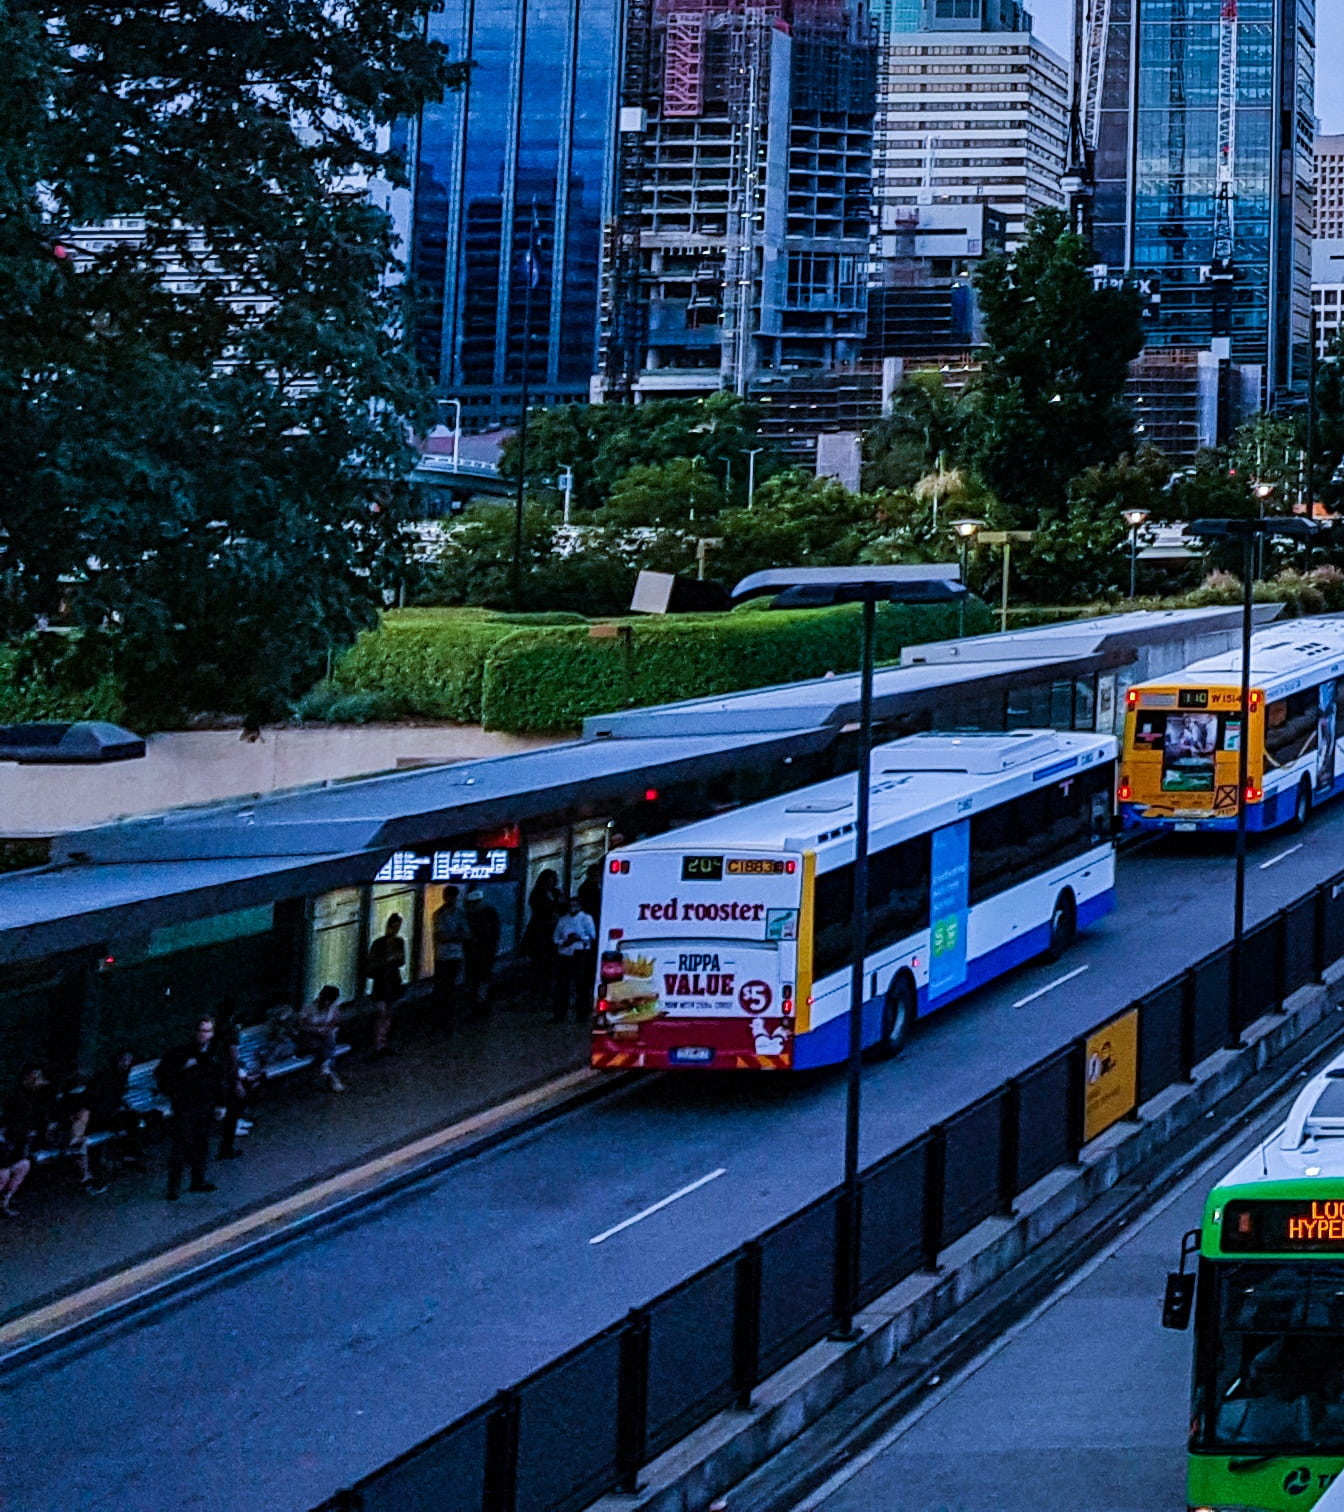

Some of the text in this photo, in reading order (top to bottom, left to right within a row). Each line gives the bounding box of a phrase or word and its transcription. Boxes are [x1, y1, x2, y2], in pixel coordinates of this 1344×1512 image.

[637, 897, 764, 922] red rooster
[678, 953, 721, 972] RIPPA
[663, 973, 735, 996] VALUE
[742, 985, 767, 1011] $5
